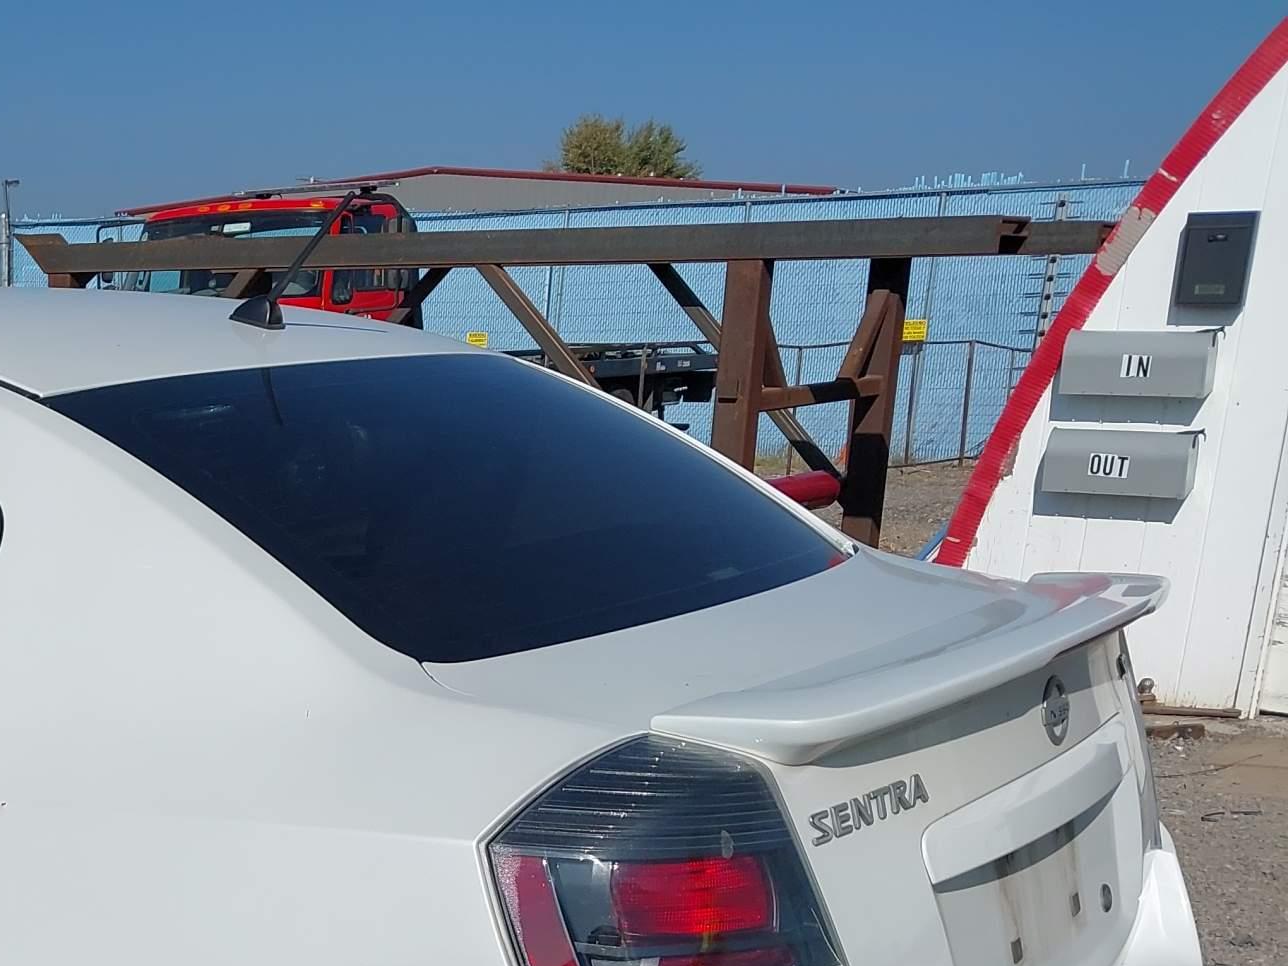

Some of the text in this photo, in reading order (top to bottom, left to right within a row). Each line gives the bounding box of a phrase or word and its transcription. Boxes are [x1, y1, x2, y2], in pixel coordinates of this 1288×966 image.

[1125, 354, 1150, 378] IN
[1089, 454, 1130, 477] OUT
[808, 773, 930, 847] SENTRA
